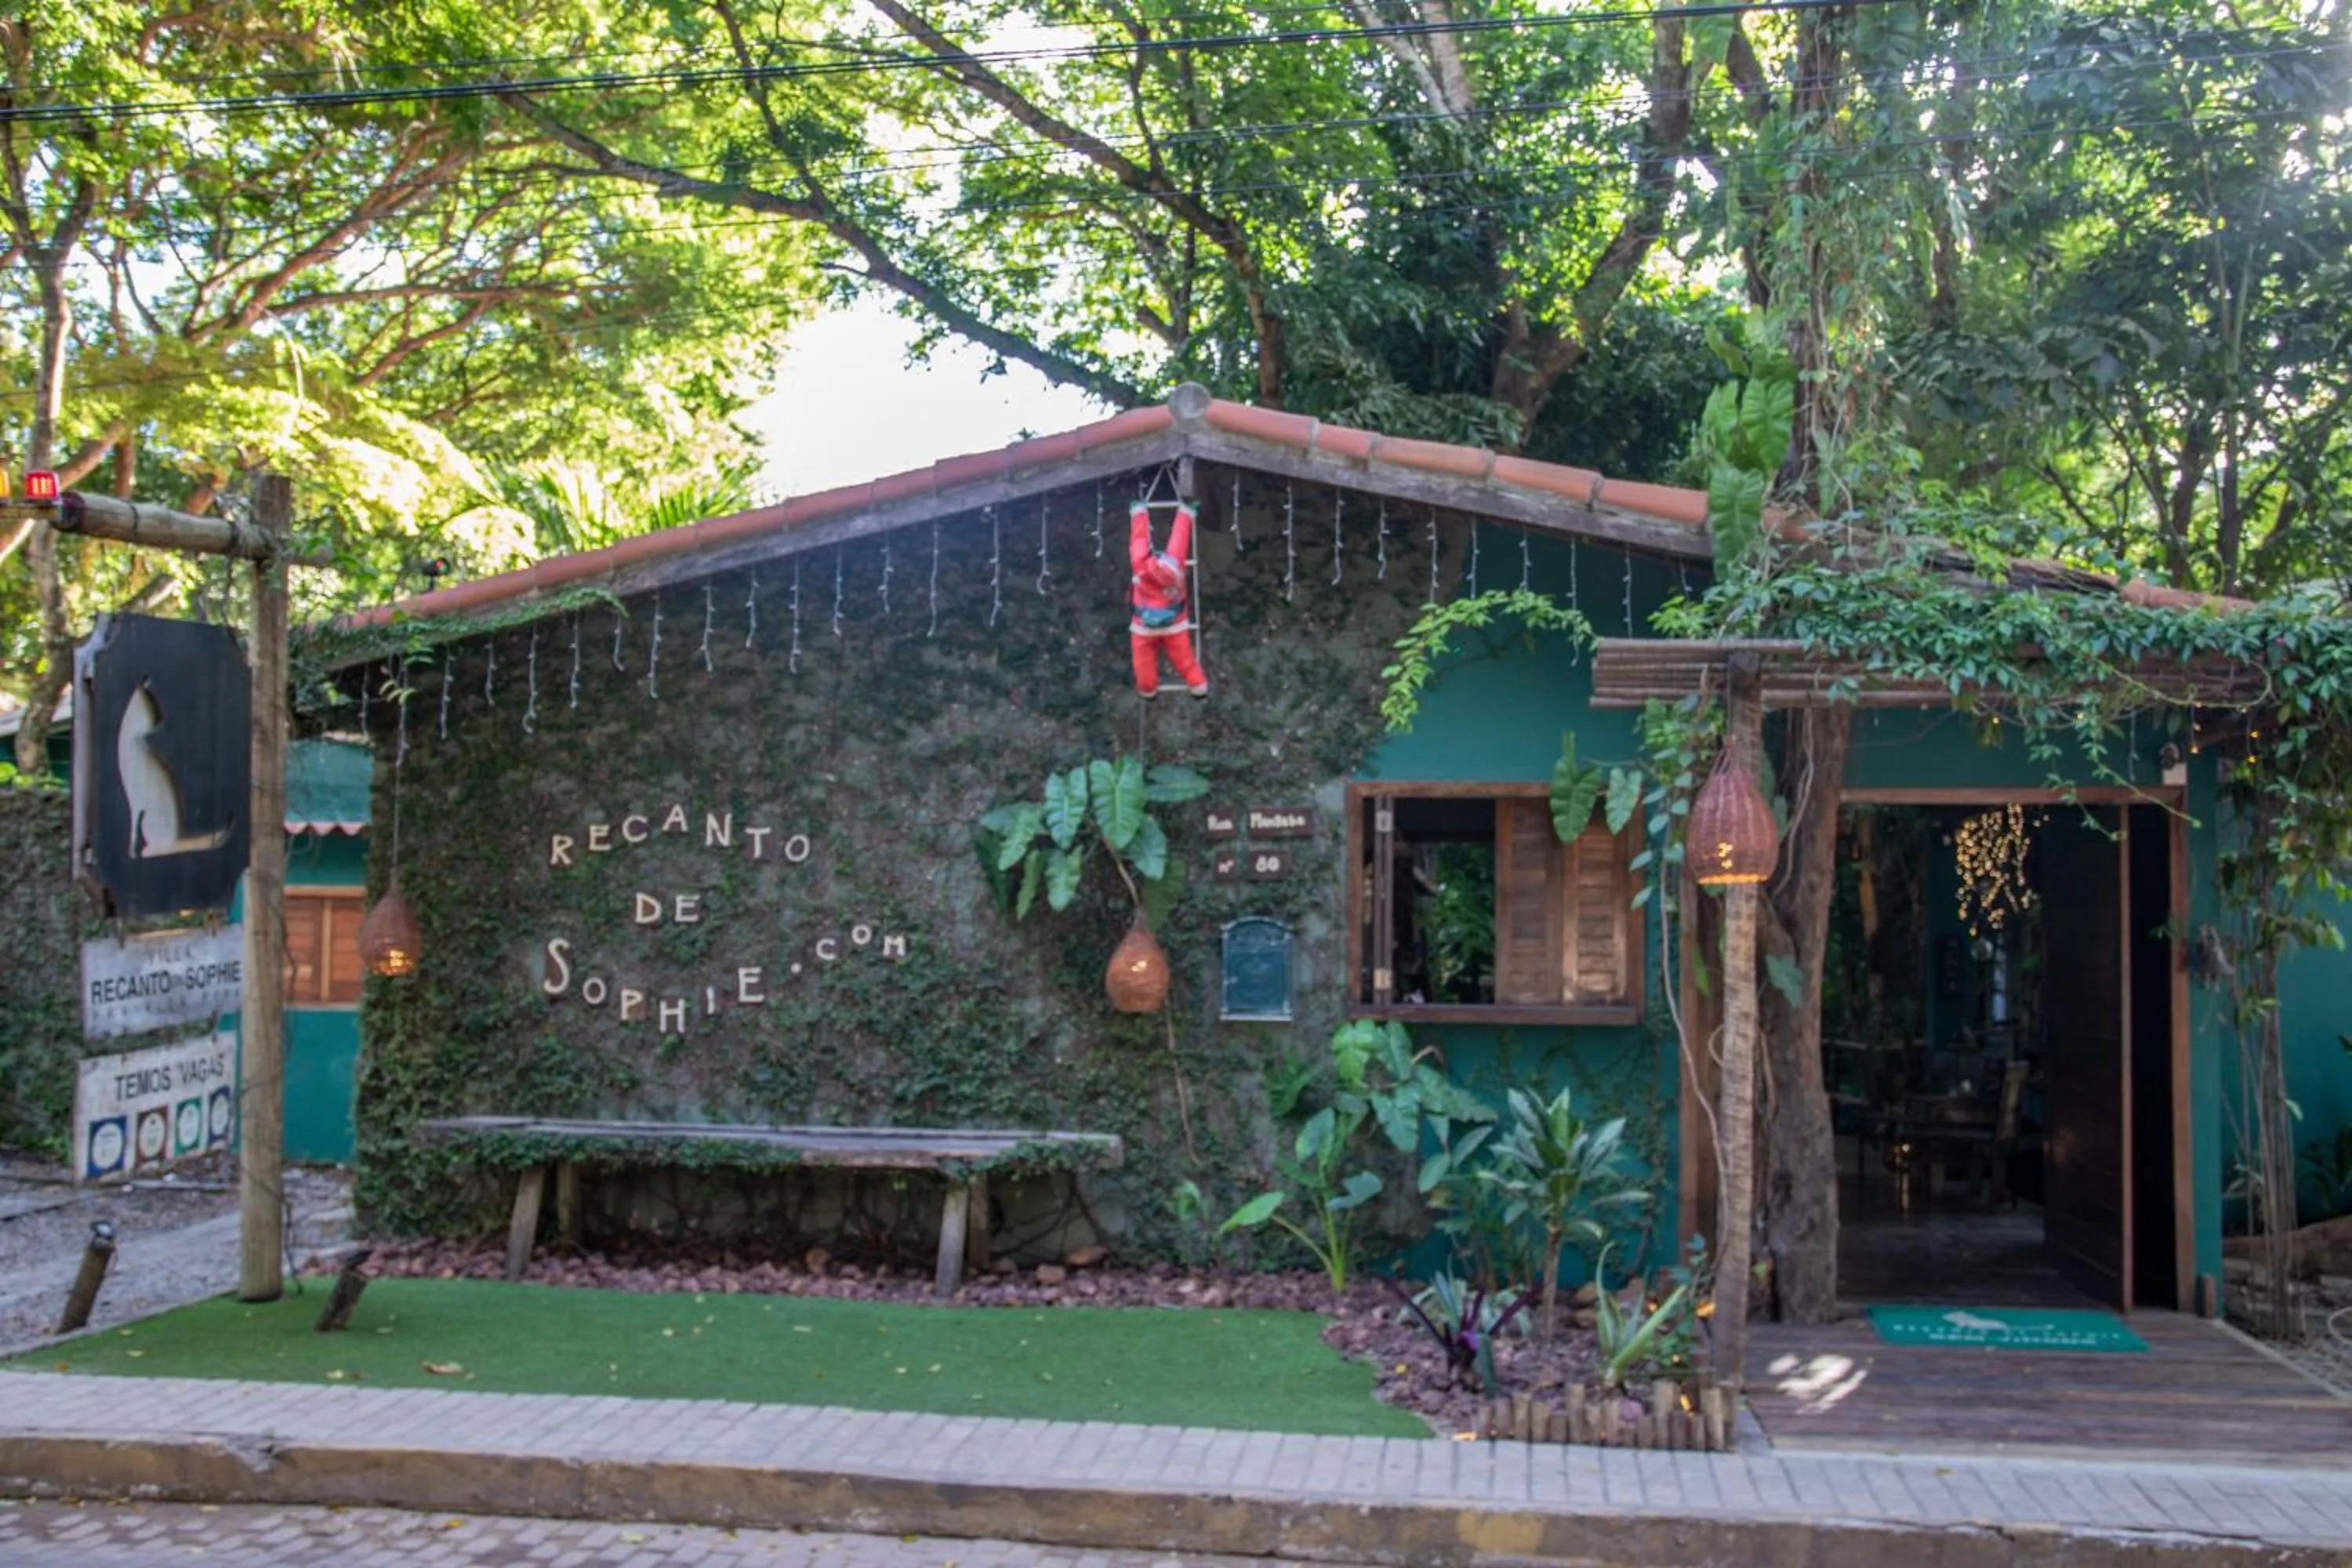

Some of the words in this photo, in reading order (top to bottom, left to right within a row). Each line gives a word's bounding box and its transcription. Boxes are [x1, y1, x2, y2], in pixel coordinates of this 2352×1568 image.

[550, 804, 811, 864] RECANTO
[635, 892, 700, 924] DE
[90, 970, 172, 1004] RECANTO
[185, 960, 242, 990] SOPHIE
[114, 1065, 172, 1102] TEMOS
[180, 1053, 224, 1084] VAGAS
